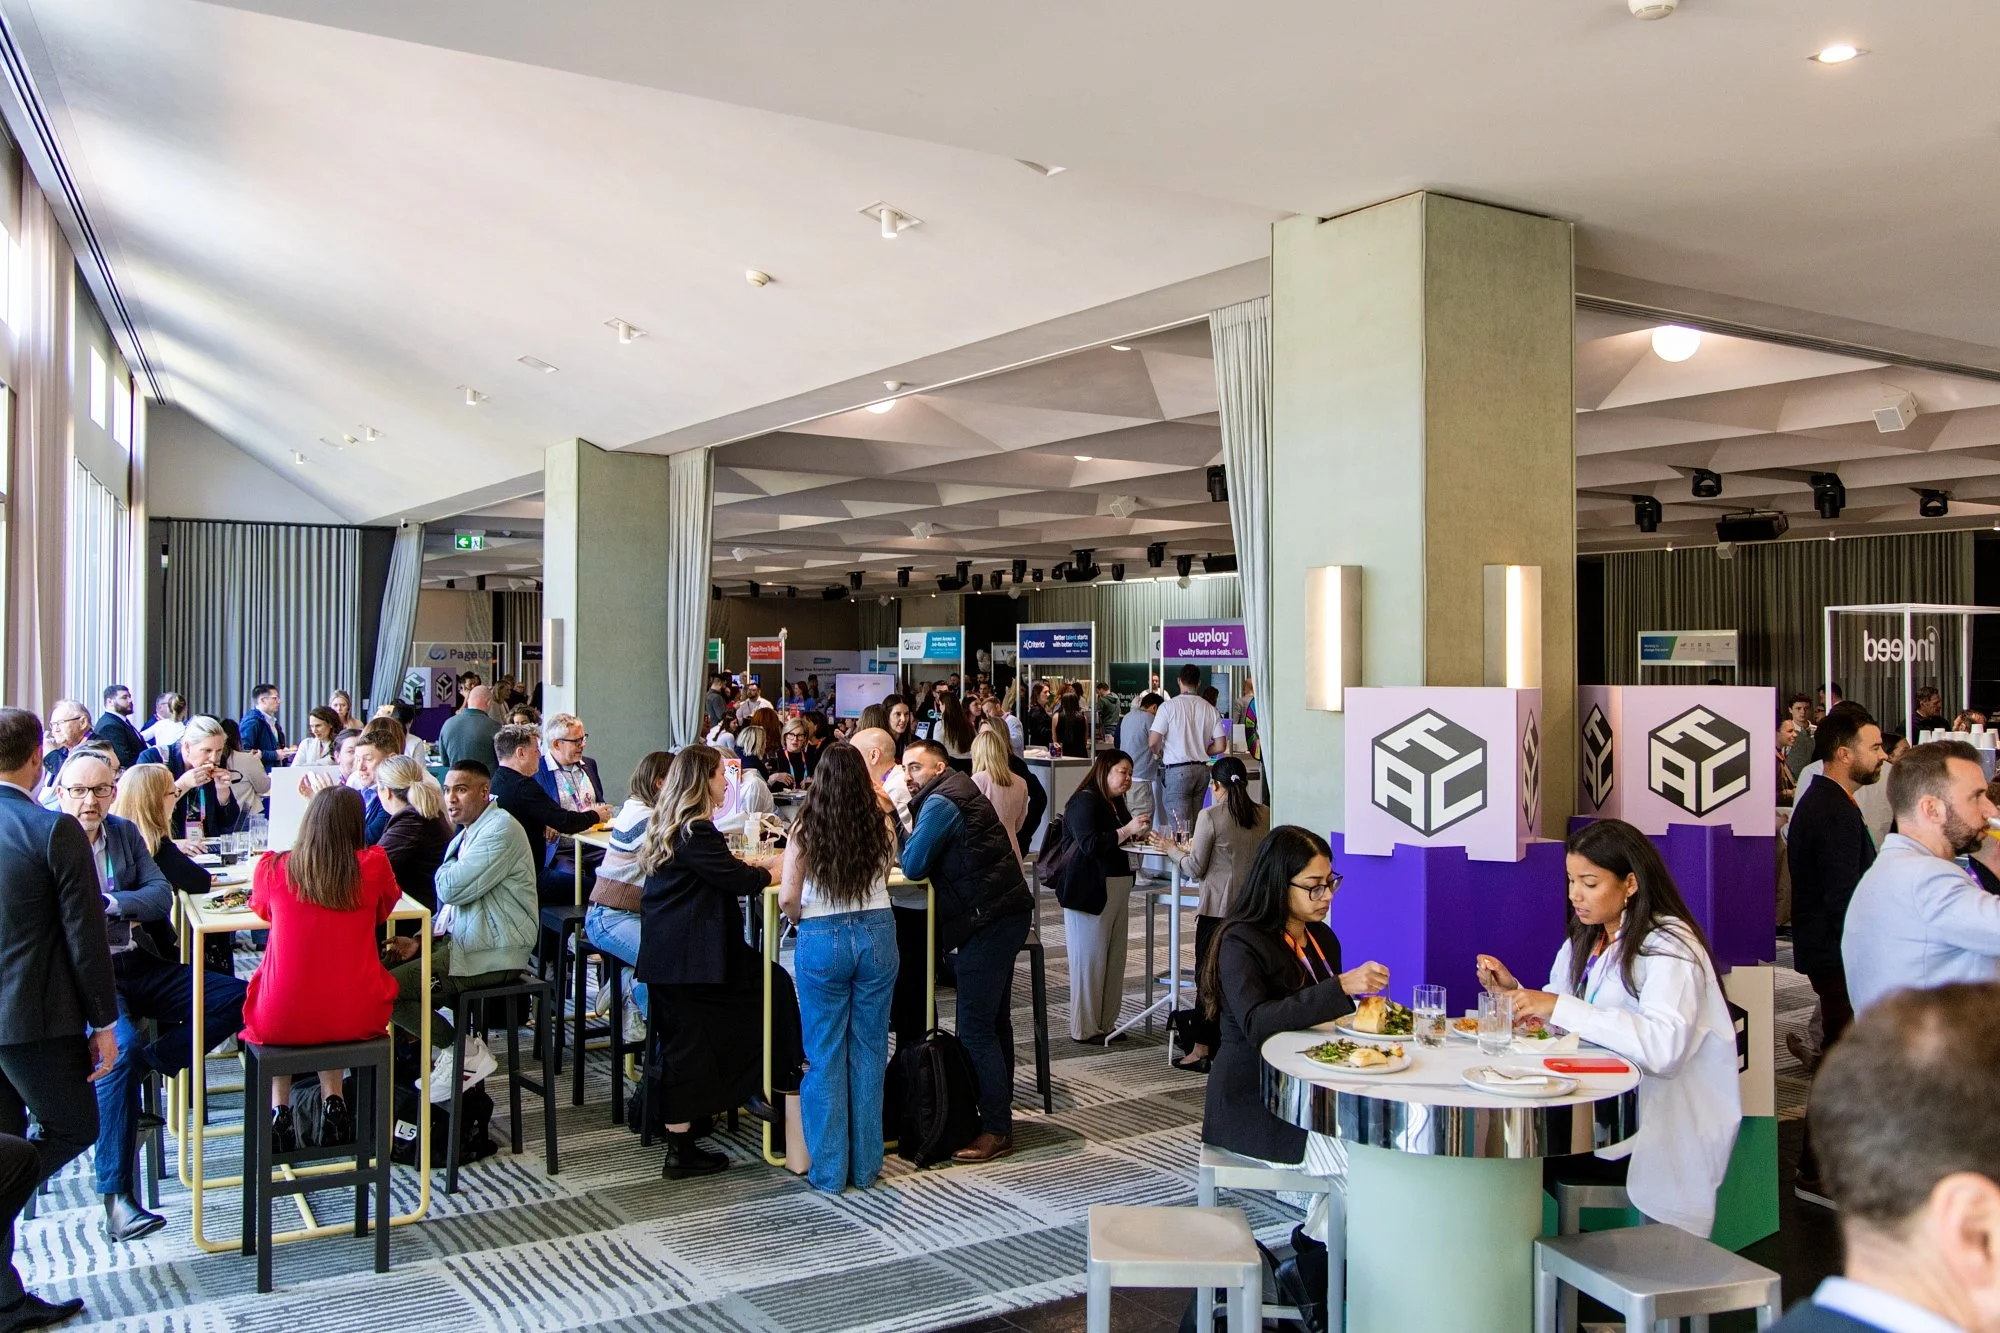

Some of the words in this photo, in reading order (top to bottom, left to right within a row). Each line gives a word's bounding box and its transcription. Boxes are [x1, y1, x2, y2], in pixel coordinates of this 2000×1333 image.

[1188, 627, 1230, 647] weploy
[1028, 640, 1045, 649] Criteria
[1073, 641, 1089, 649] insights
[450, 648, 493, 661] PageUp
[1178, 648, 1196, 657] Quality
[1196, 648, 1209, 656] Bums
[1216, 648, 1231, 656] Seats.
[1232, 648, 1244, 656] Fast.
